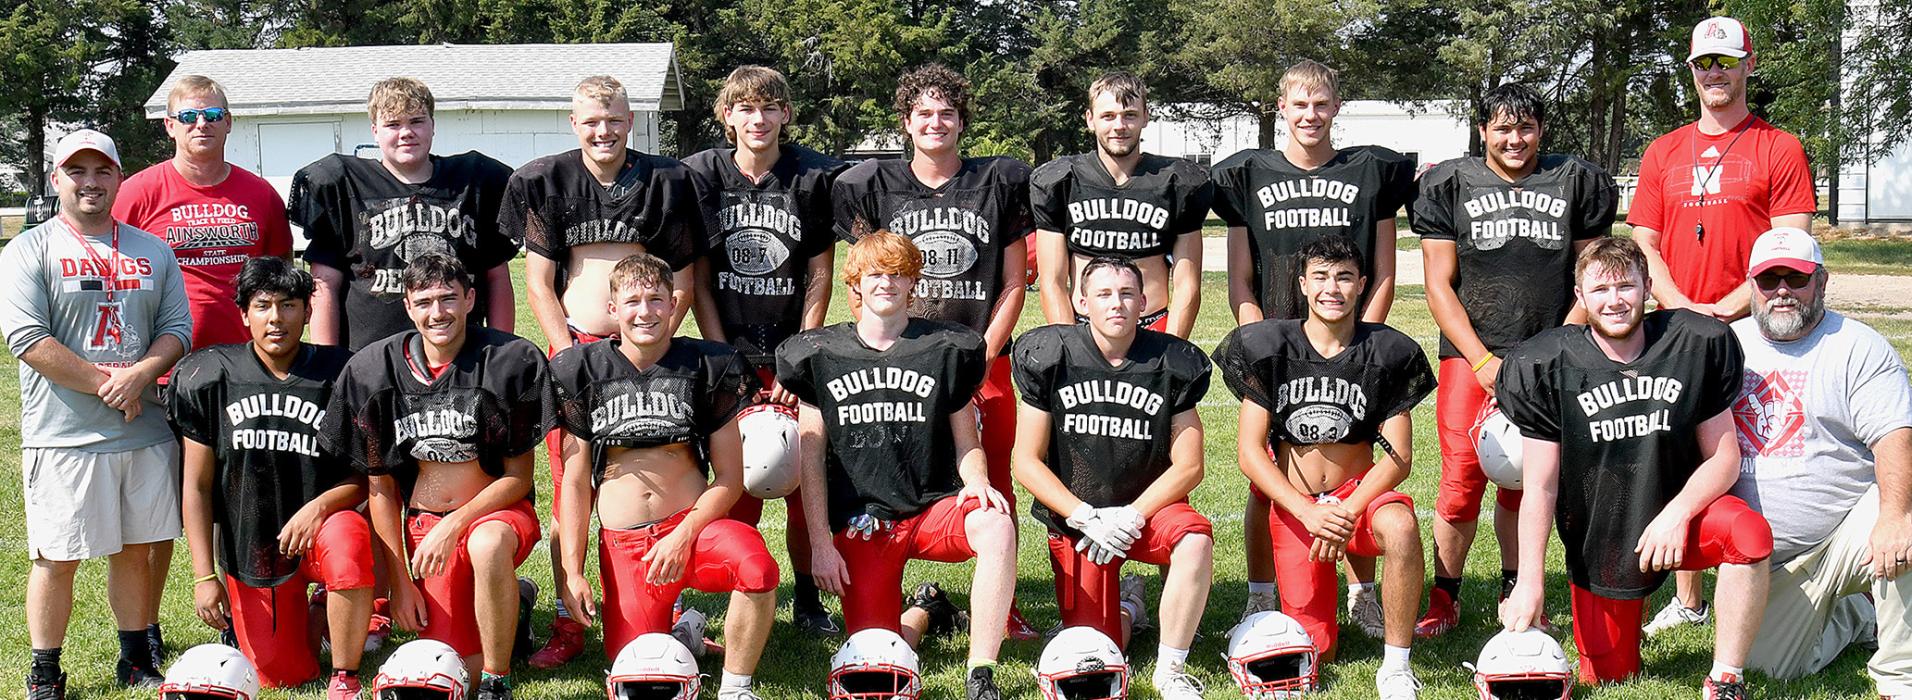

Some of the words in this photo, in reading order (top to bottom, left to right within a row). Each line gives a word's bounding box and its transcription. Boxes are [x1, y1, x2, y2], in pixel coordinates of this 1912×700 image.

[1256, 178, 1360, 209] BULLDOG
[1464, 190, 1568, 219] BULLDOG
[171, 203, 249, 223] BULLDOG
[889, 206, 990, 244] BULLDOG
[1067, 198, 1169, 230] BULLDOG
[1264, 207, 1351, 231] FOOTBALL
[166, 222, 260, 245] AINSWORTH
[1070, 226, 1161, 250] FOOTBALL
[1470, 217, 1562, 241] FOOTBALL
[203, 249, 227, 257] STATE
[826, 367, 936, 403] BULLDOG
[1058, 380, 1164, 416] BULLDOG
[1576, 376, 1683, 418] BULLDOG
[837, 402, 926, 426] FOOTBALL
[1063, 413, 1152, 440] FOOTBALL
[1589, 409, 1671, 443] FOOTBALL
[232, 428, 320, 457] FOOTBALL
